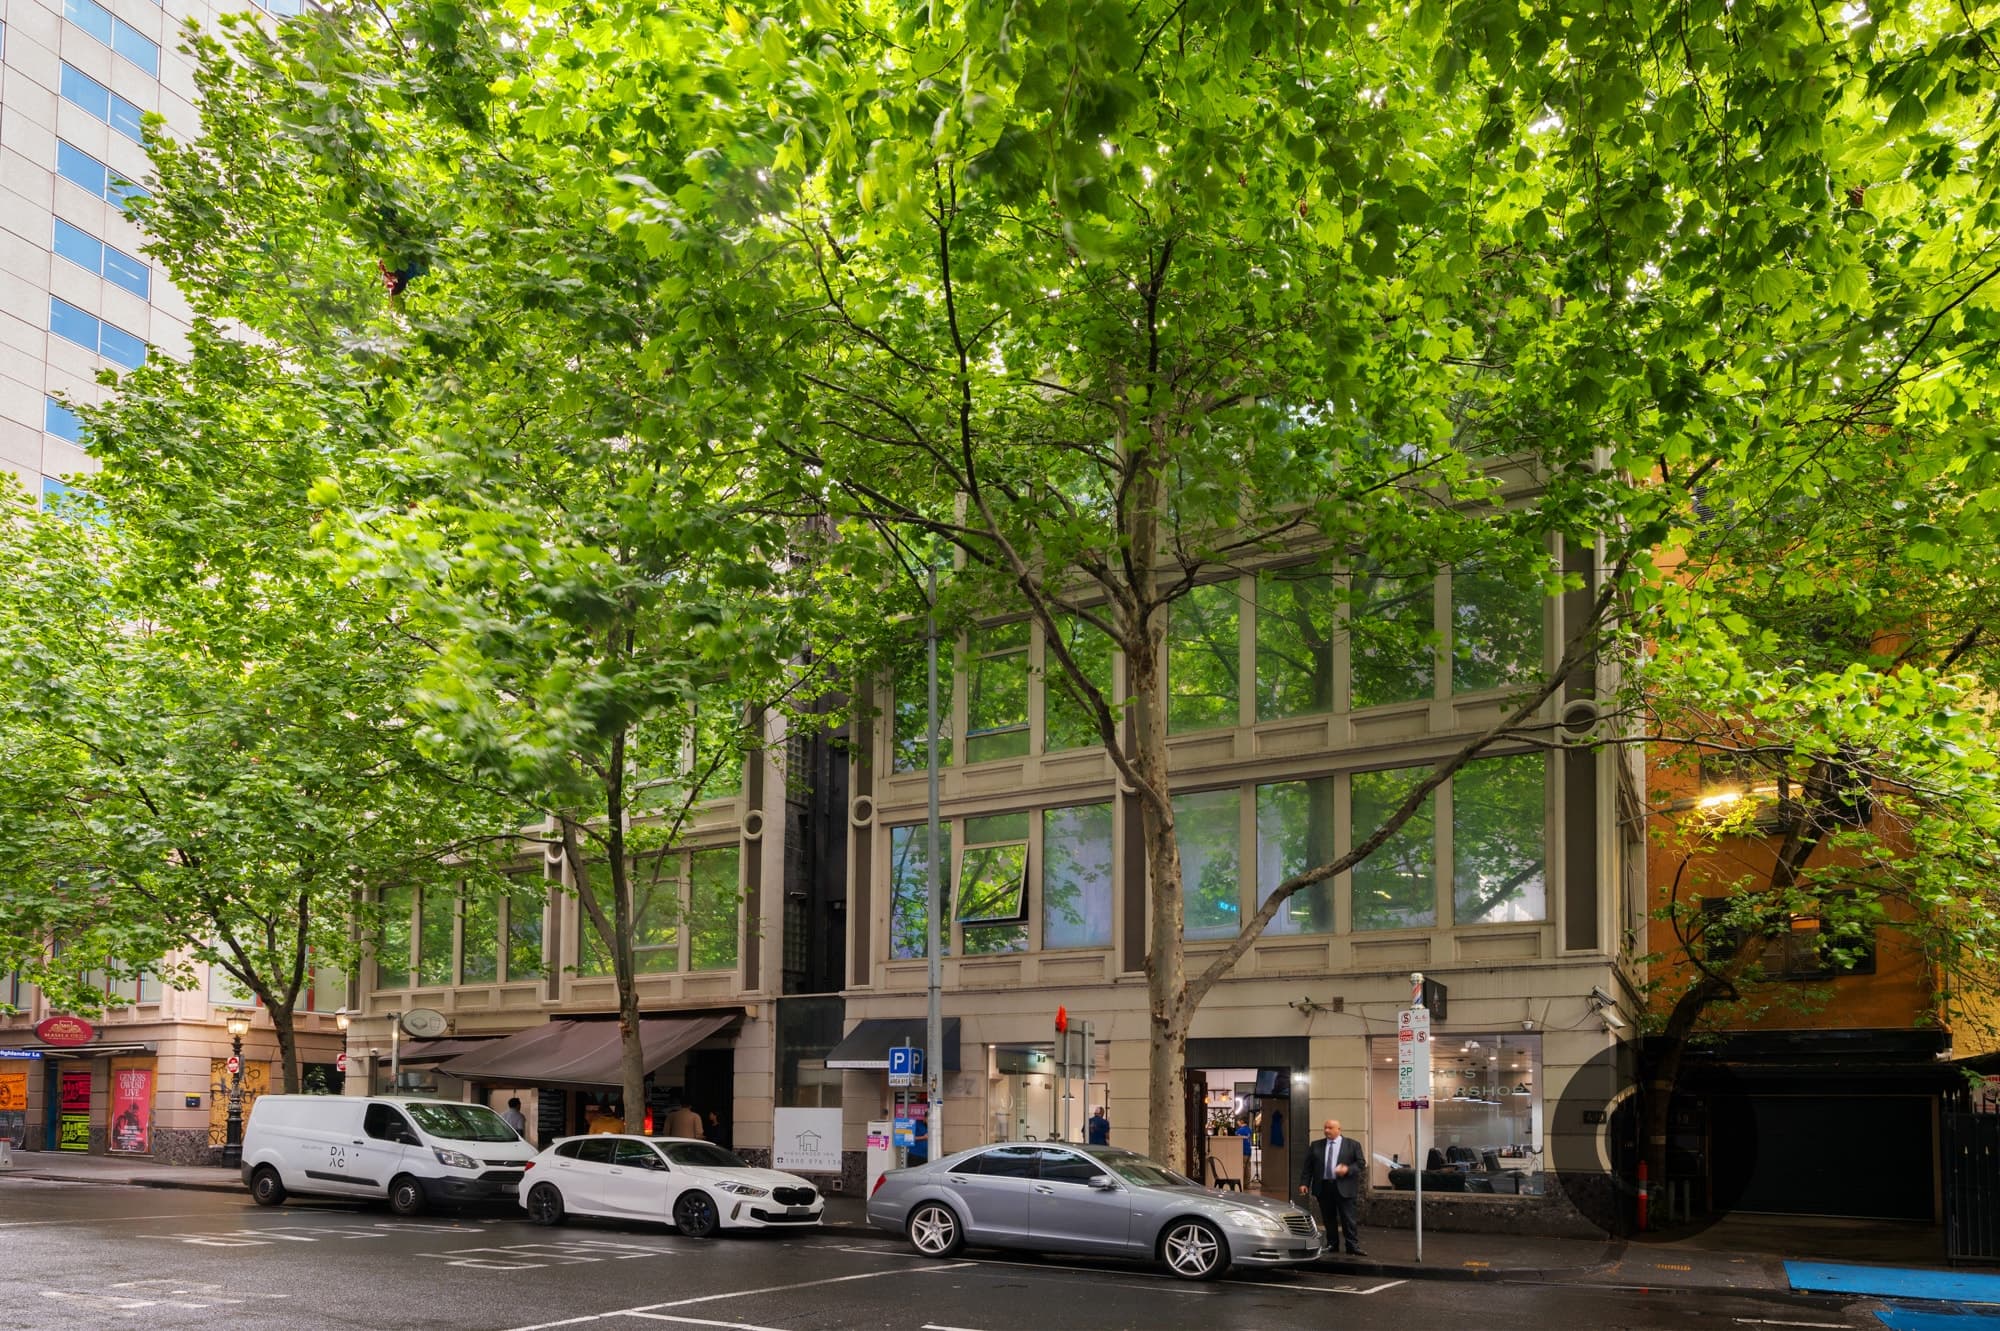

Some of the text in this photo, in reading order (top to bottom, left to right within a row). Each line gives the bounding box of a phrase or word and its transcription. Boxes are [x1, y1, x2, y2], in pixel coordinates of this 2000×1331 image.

[894, 1052, 905, 1070] P
[913, 1053, 920, 1070] P
[1400, 1067, 1413, 1077] 2P
[119, 1073, 146, 1082] GENESIS
[124, 1088, 140, 1097] LIVE
